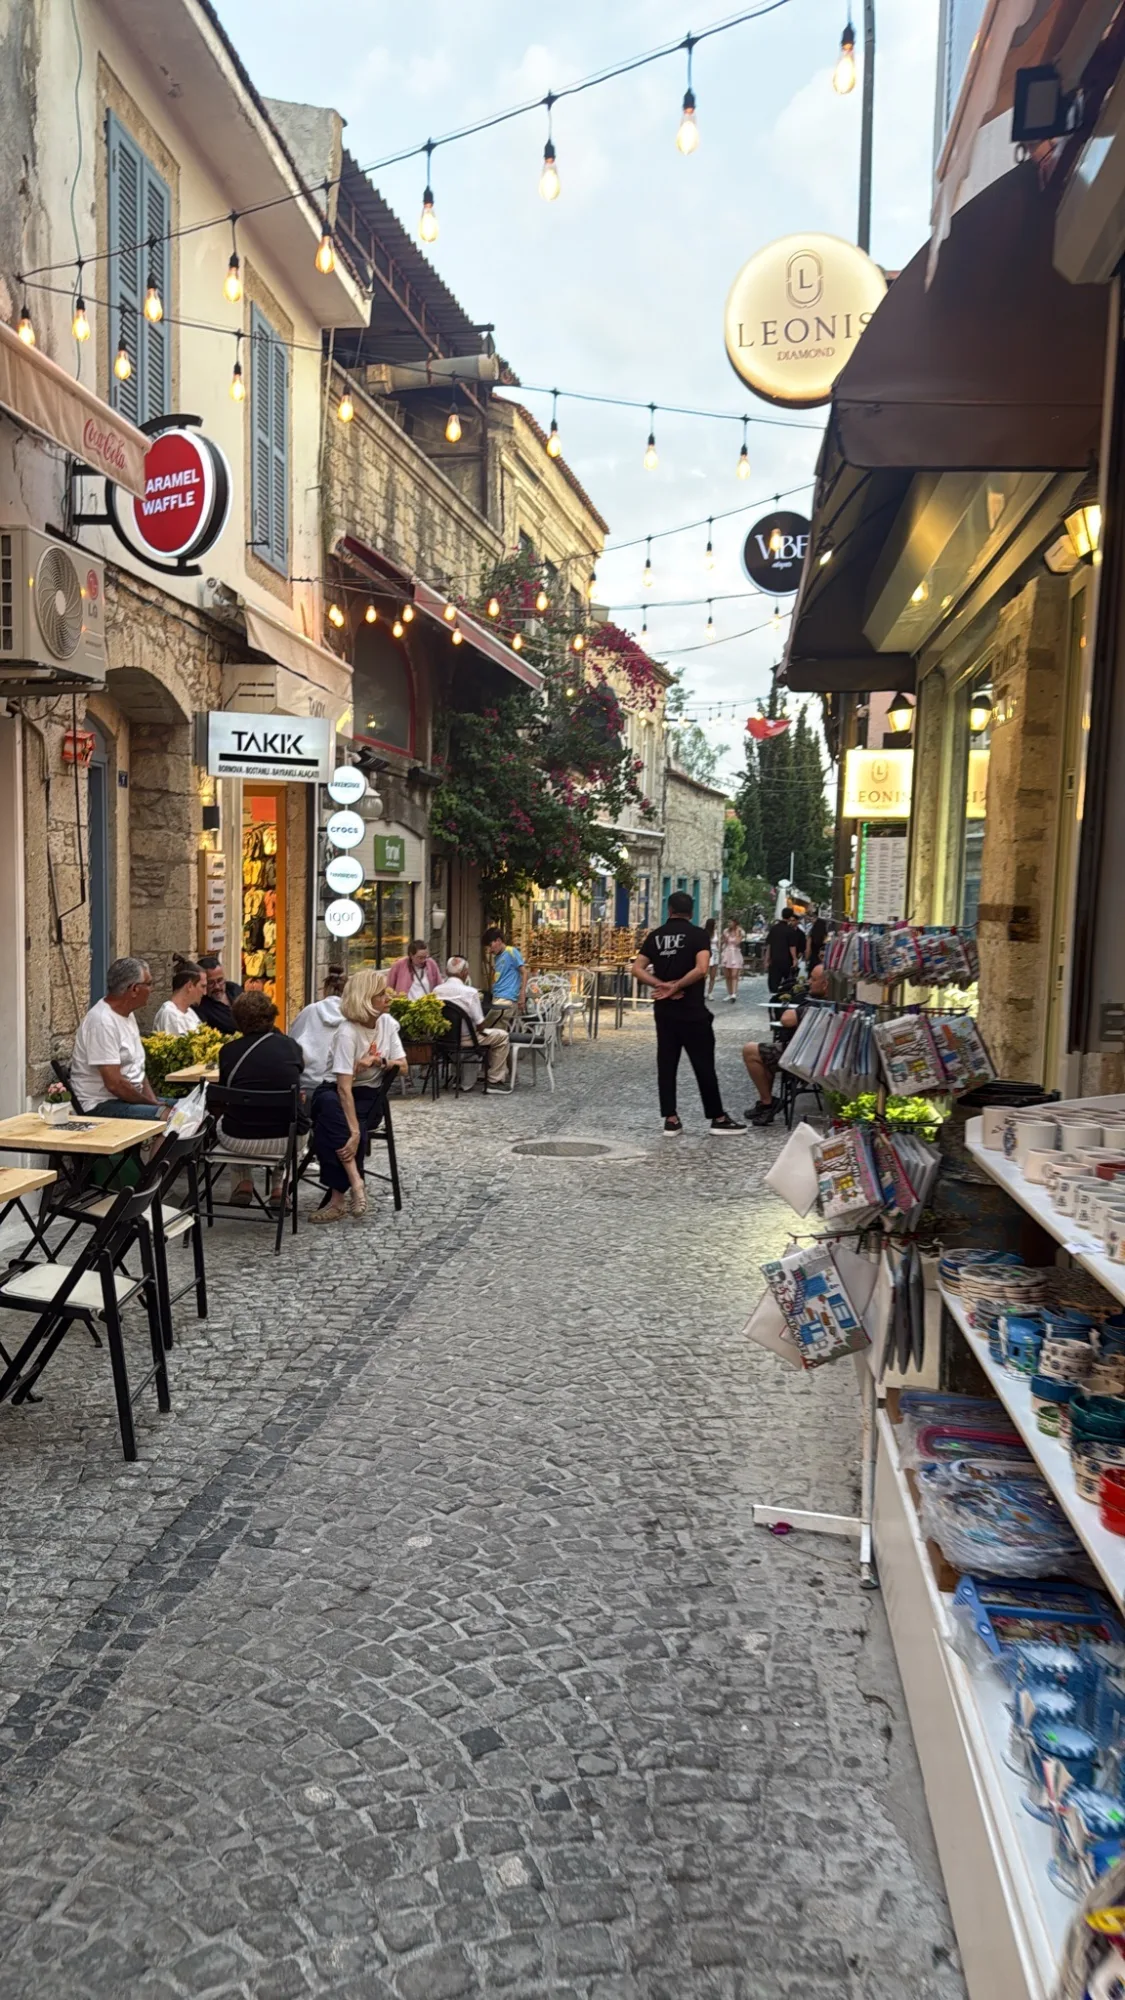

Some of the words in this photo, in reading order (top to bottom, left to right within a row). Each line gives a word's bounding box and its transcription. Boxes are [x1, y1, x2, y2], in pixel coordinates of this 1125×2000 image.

[799, 269, 813, 289] L
[738, 312, 874, 347] LEONIS
[777, 347, 835, 361] DIAMOND
[84, 419, 128, 470] Coca-Cola
[145, 469, 200, 494] ARAMEL
[141, 491, 195, 516] WAFFLE
[88, 603, 98, 618] LG
[231, 731, 304, 755] TAKIK
[330, 826, 358, 834] crocs
[329, 910, 356, 926] igor
[655, 933, 686, 950] VIBE
